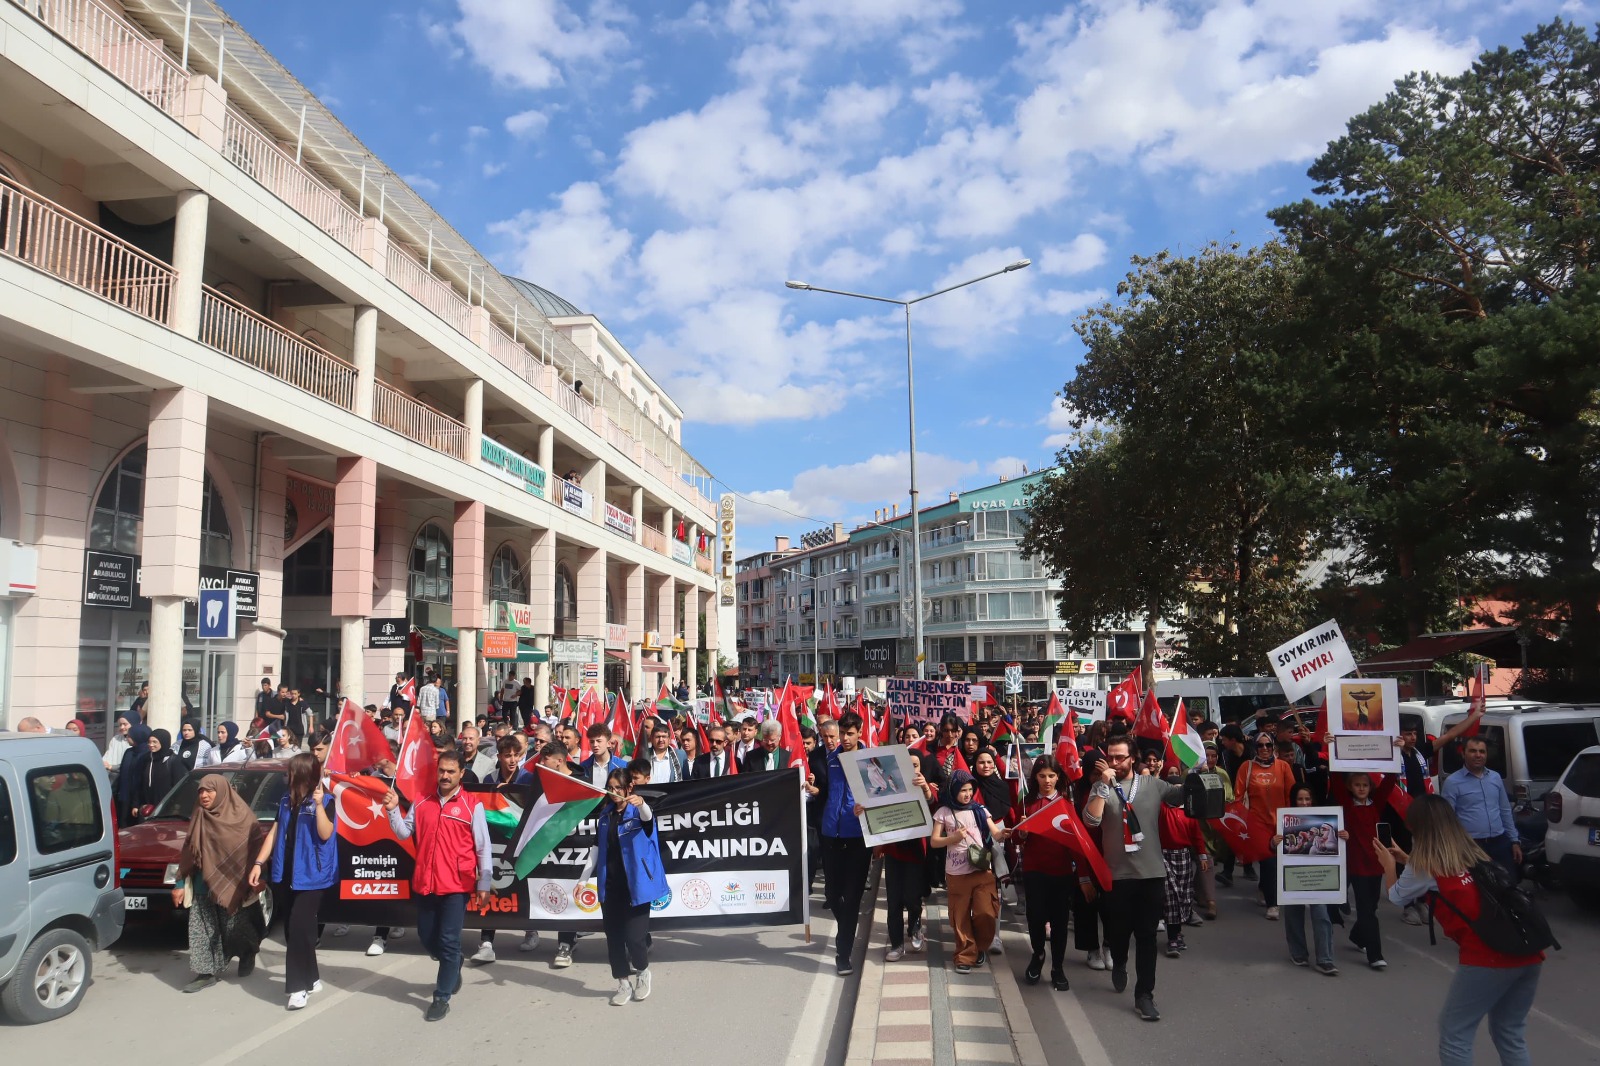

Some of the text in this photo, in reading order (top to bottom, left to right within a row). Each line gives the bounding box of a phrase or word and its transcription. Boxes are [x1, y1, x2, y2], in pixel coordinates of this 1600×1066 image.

[972, 499, 1006, 510] UÇAR
[722, 520, 734, 580] OTEL
[99, 560, 122, 570] AVUKAT
[93, 569, 126, 579] ARABULUCU
[99, 584, 120, 594] Zeynep
[864, 645, 890, 661] bambi
[1277, 629, 1339, 667] SOYKIRIMA
[1291, 651, 1335, 682] HAYIR!
[886, 679, 972, 695] ZULMEDENLERE
[886, 691, 966, 708] MEYLETMEYİN
[657, 800, 760, 833] ENÇLİĞİ
[666, 837, 788, 859] YANINDA
[351, 855, 398, 867] Direnişin
[354, 867, 396, 880] Simgesi
[351, 883, 399, 895] GAZZE
[755, 892, 775, 900] MESLEK
[128, 899, 146, 907] 464
